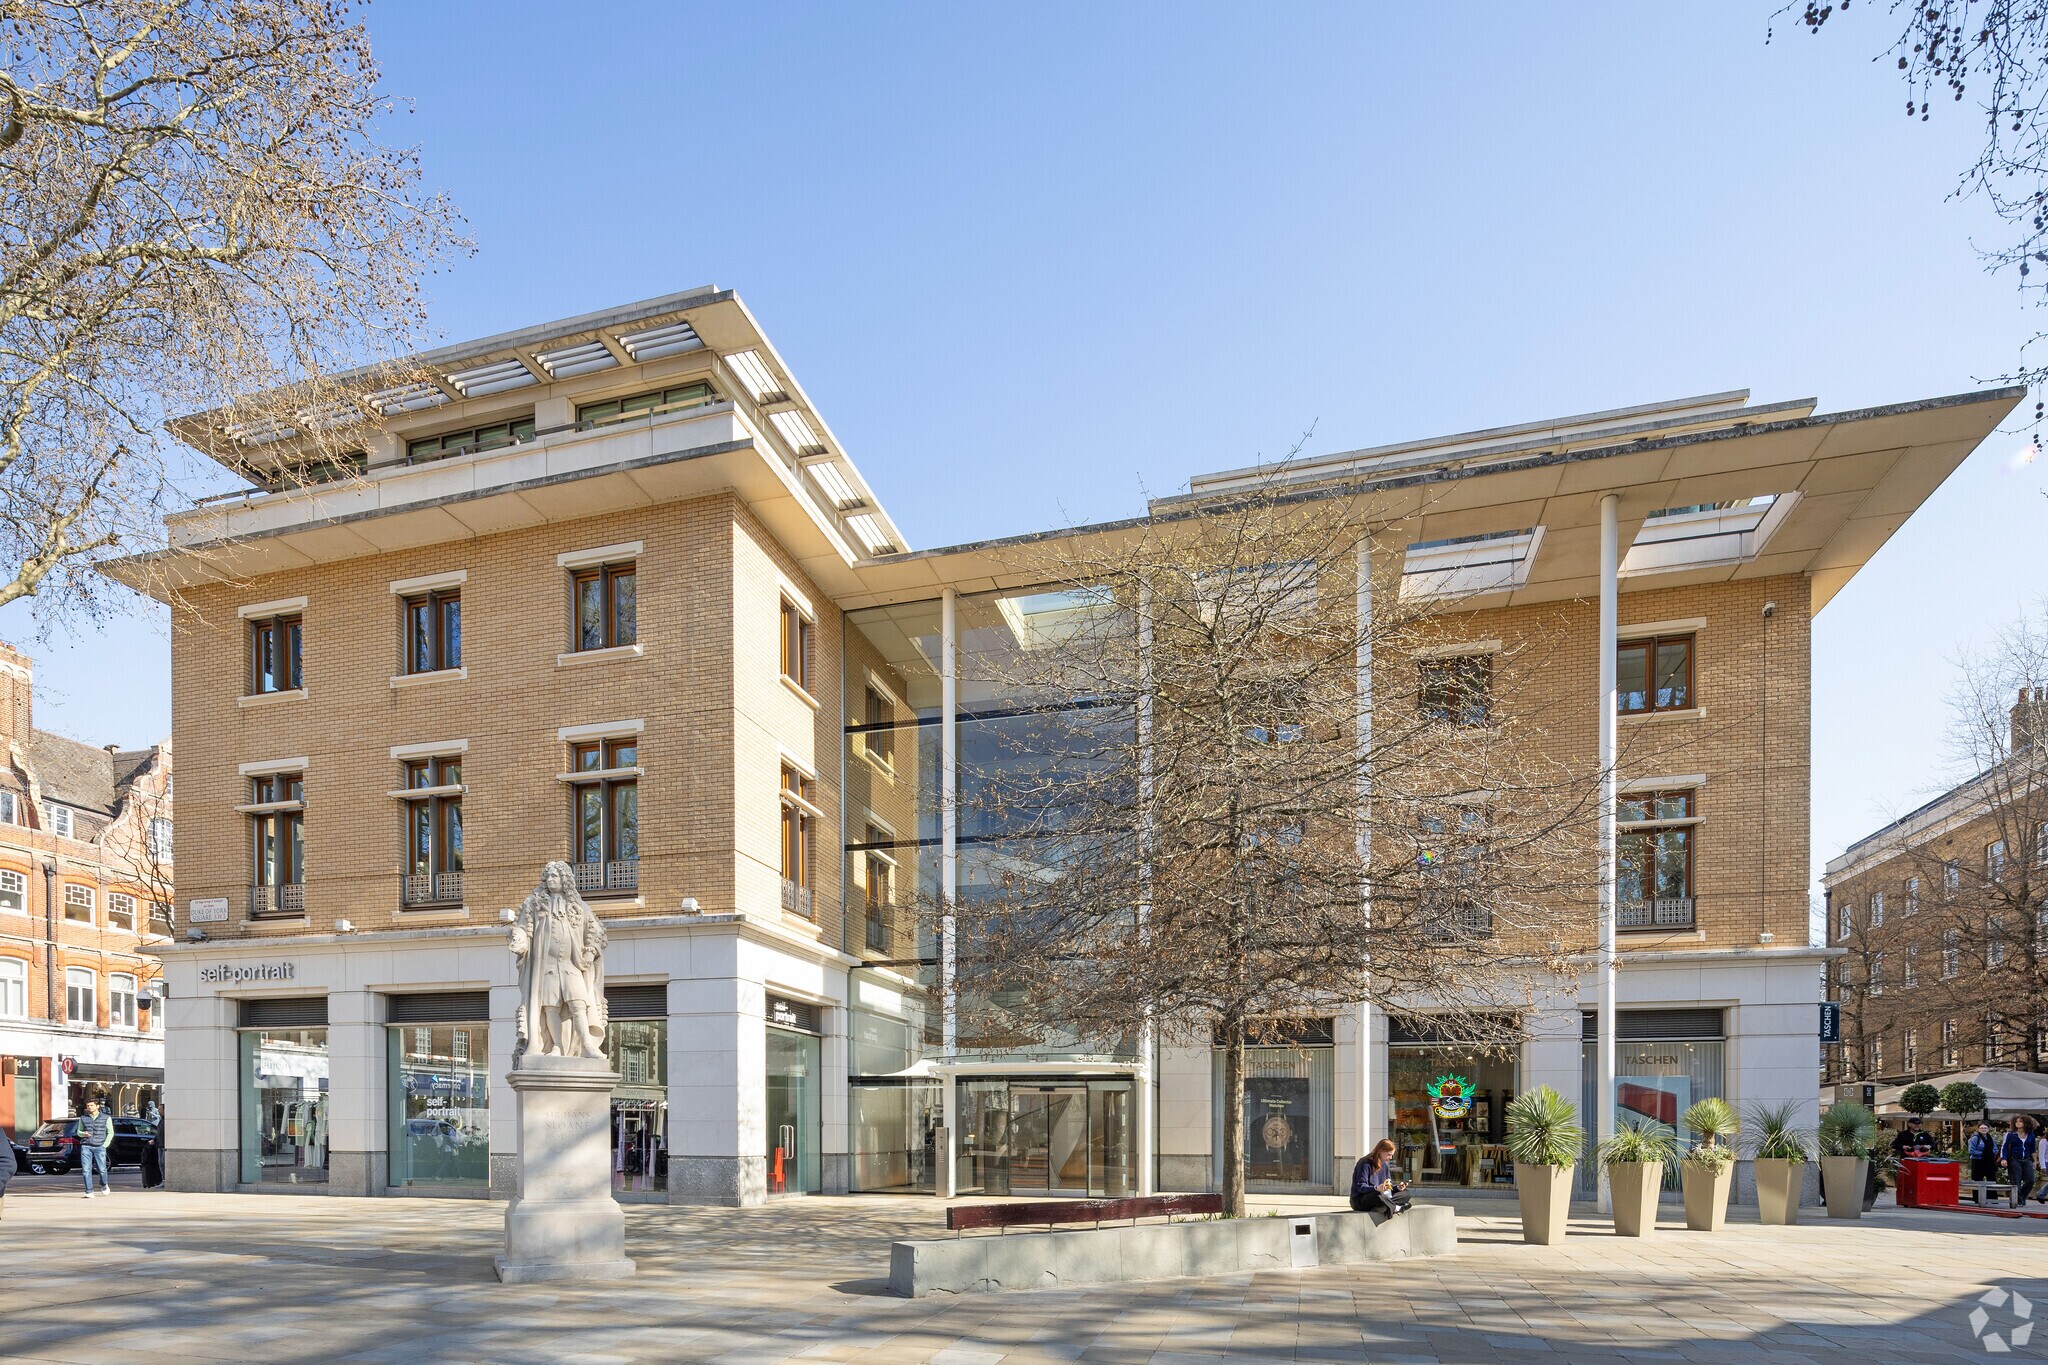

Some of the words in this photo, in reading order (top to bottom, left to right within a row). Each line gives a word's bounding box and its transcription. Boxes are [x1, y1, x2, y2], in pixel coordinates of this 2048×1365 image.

[200, 963, 293, 983] self-portrait
[1823, 1005, 1831, 1037] TASCHEN
[1624, 1056, 1678, 1065] TASCHEN
[1251, 1061, 1296, 1070] TASCHEN
[426, 1097, 447, 1106] self-
[426, 1106, 461, 1117] portrait
[544, 1111, 560, 1119] SIR
[564, 1111, 591, 1119] HANS
[544, 1121, 591, 1130] SLOANE
